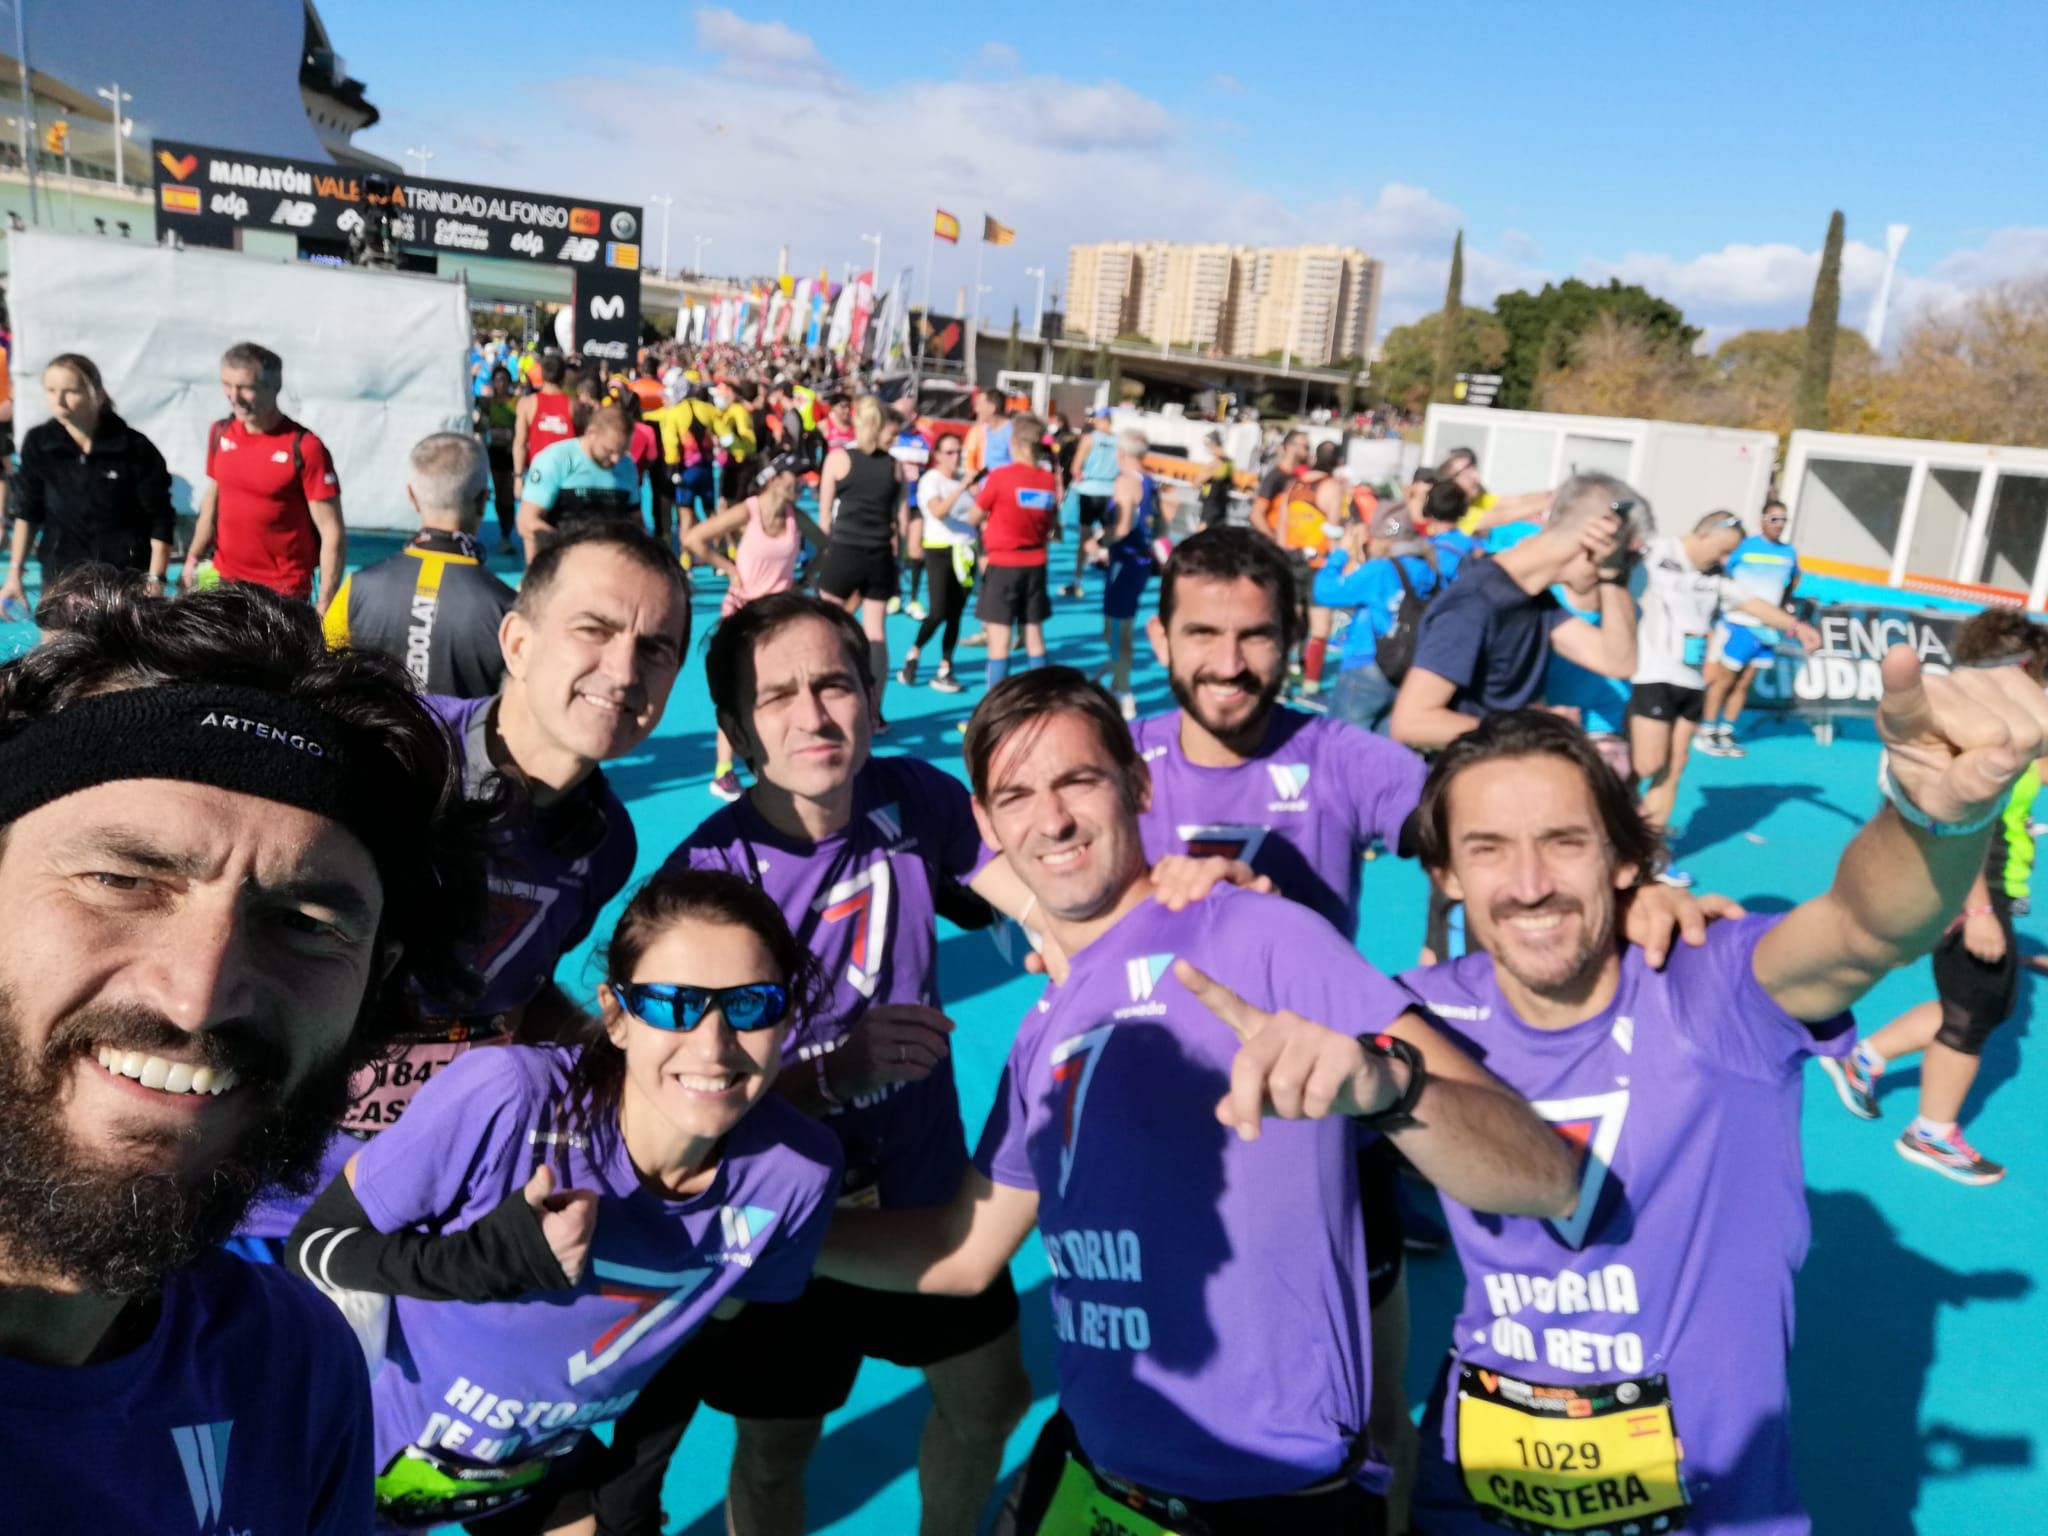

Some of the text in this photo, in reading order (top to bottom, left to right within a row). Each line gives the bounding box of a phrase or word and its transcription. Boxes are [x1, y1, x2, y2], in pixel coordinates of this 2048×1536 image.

[209, 160, 312, 195] MARATÓN
[403, 186, 487, 218] TRINIDAD
[486, 197, 569, 229] ALFONSO
[211, 191, 248, 221] edp
[510, 230, 544, 257] edp
[200, 711, 323, 757] ARTENGO
[1080, 1301, 1151, 1351] RETO
[1543, 1328, 1643, 1375] RETO
[1516, 1437, 1601, 1471] 1029
[1488, 1472, 1651, 1519] CASTERA
